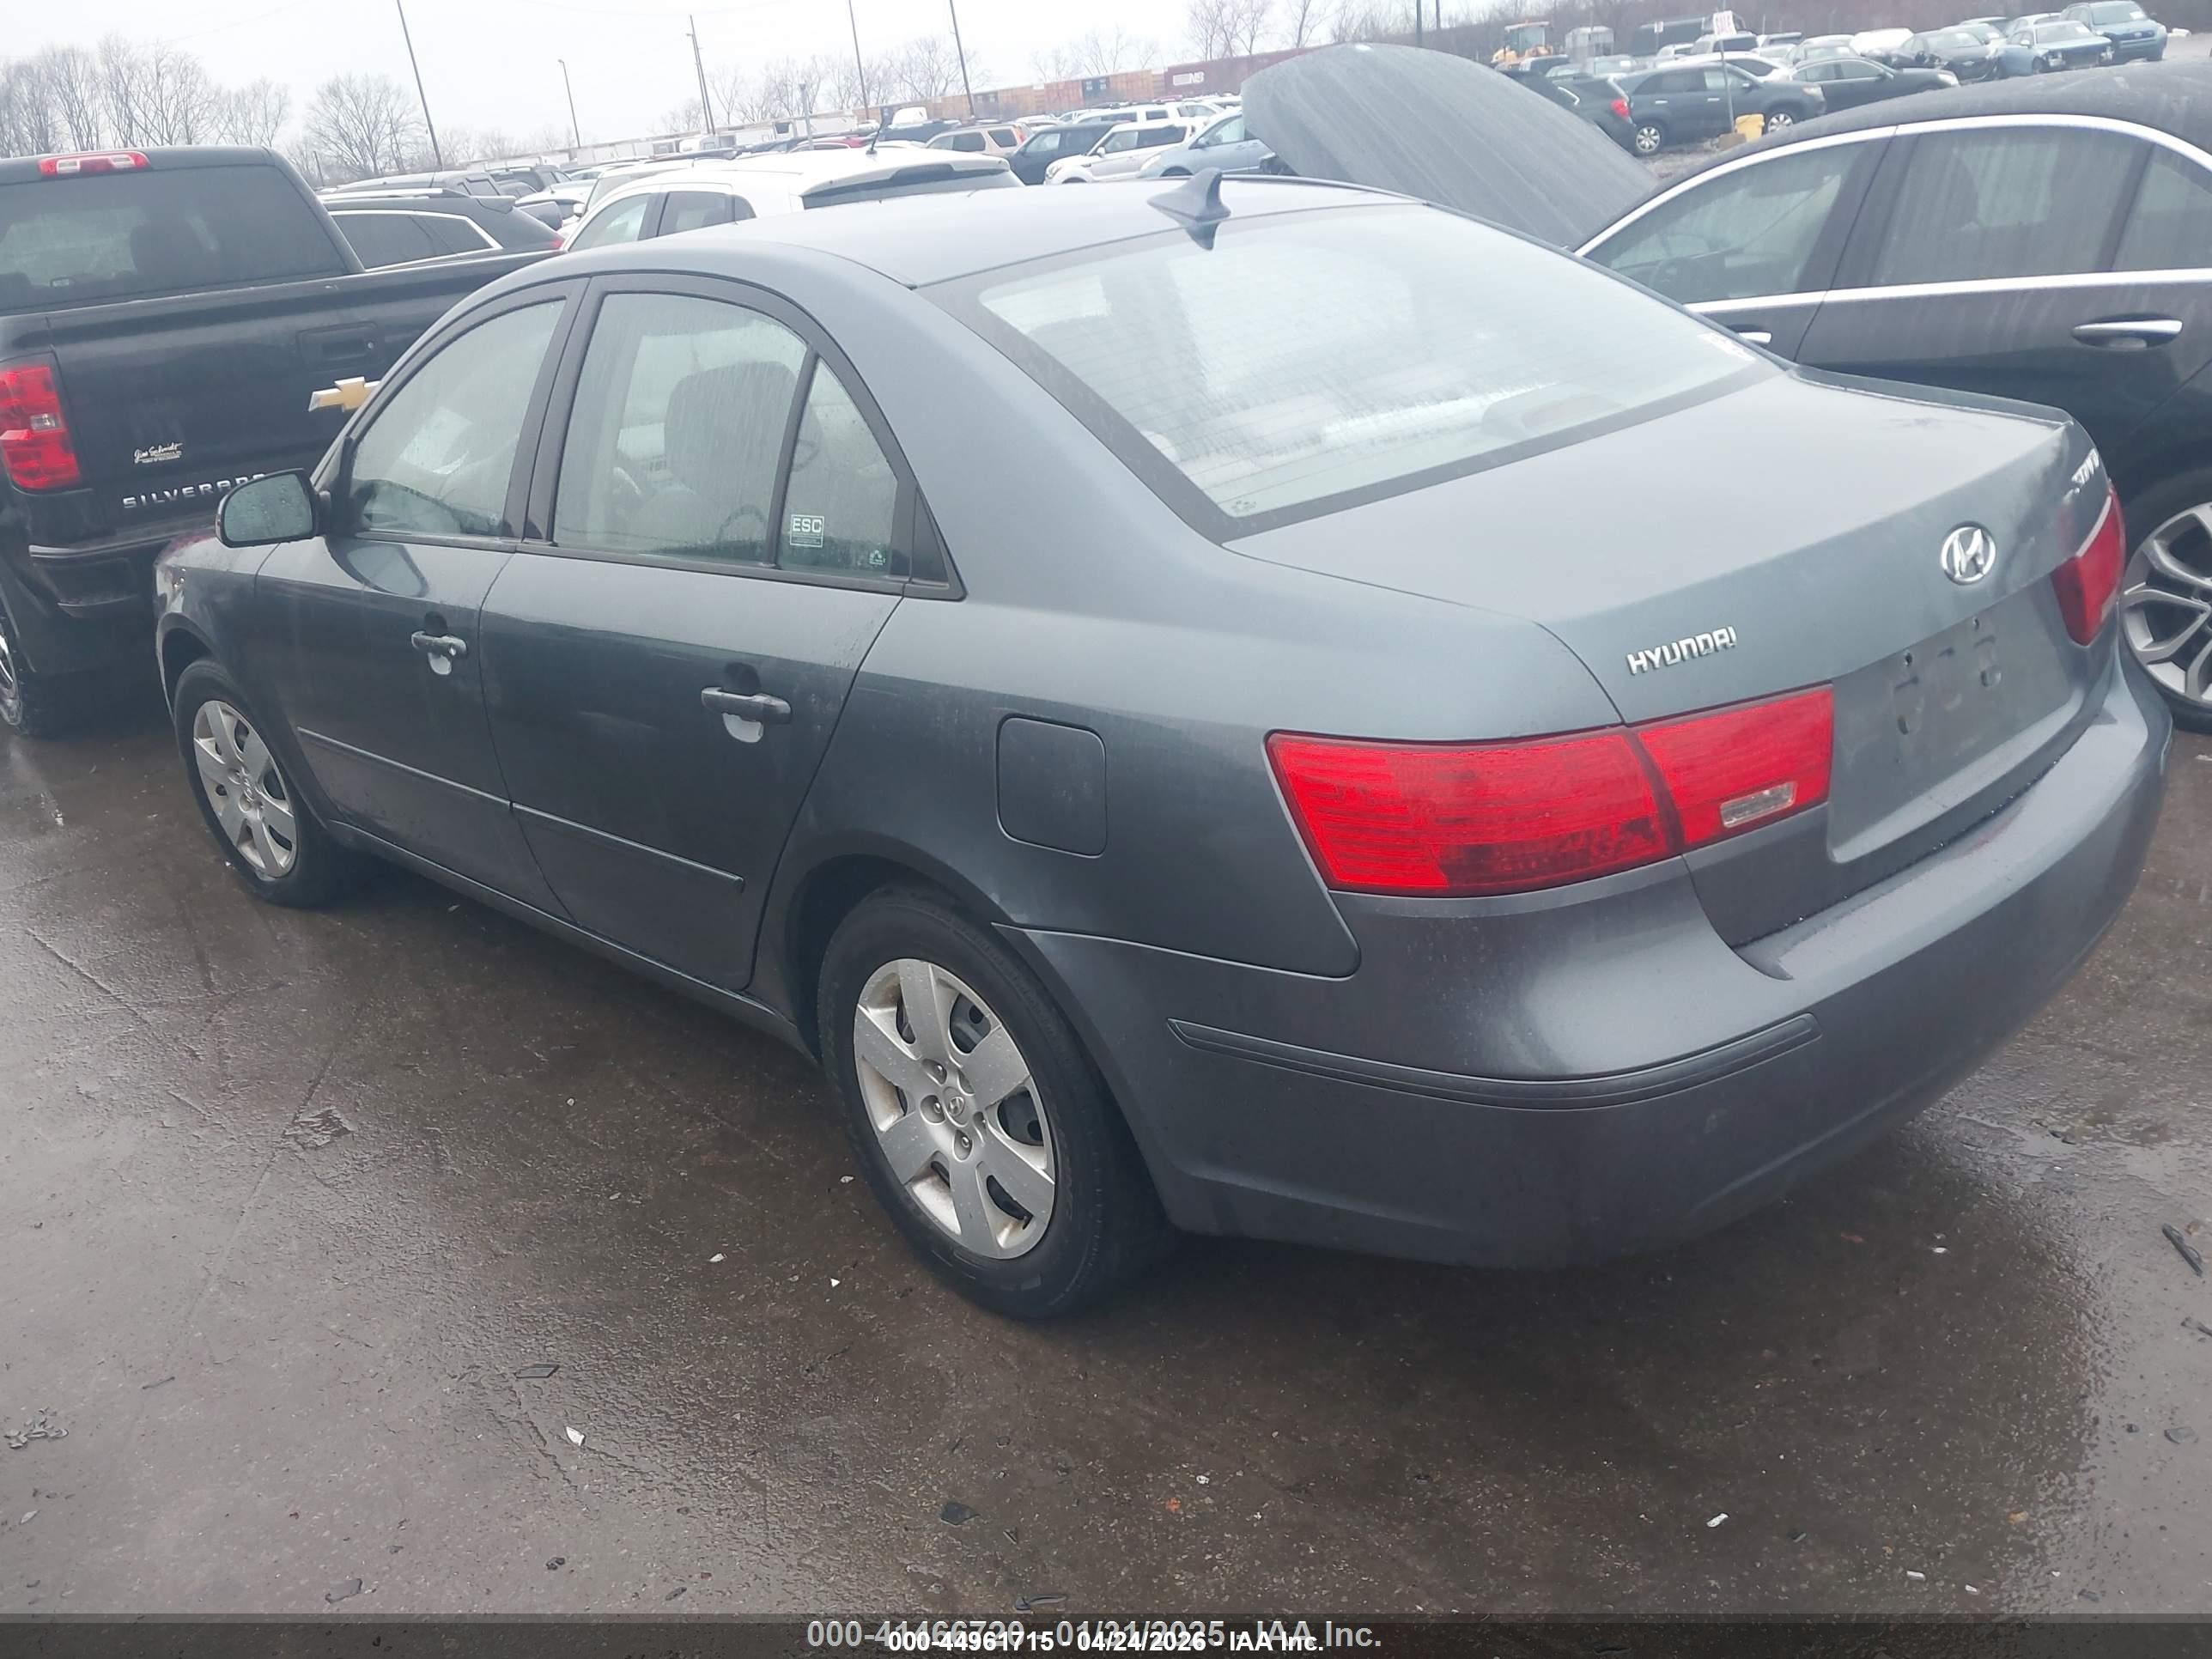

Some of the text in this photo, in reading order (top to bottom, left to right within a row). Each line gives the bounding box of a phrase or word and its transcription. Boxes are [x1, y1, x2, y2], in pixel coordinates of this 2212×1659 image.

[123, 473, 265, 508] SILVERAD
[792, 517, 823, 533] ESC
[1626, 625, 1737, 675] HYUNDAI
